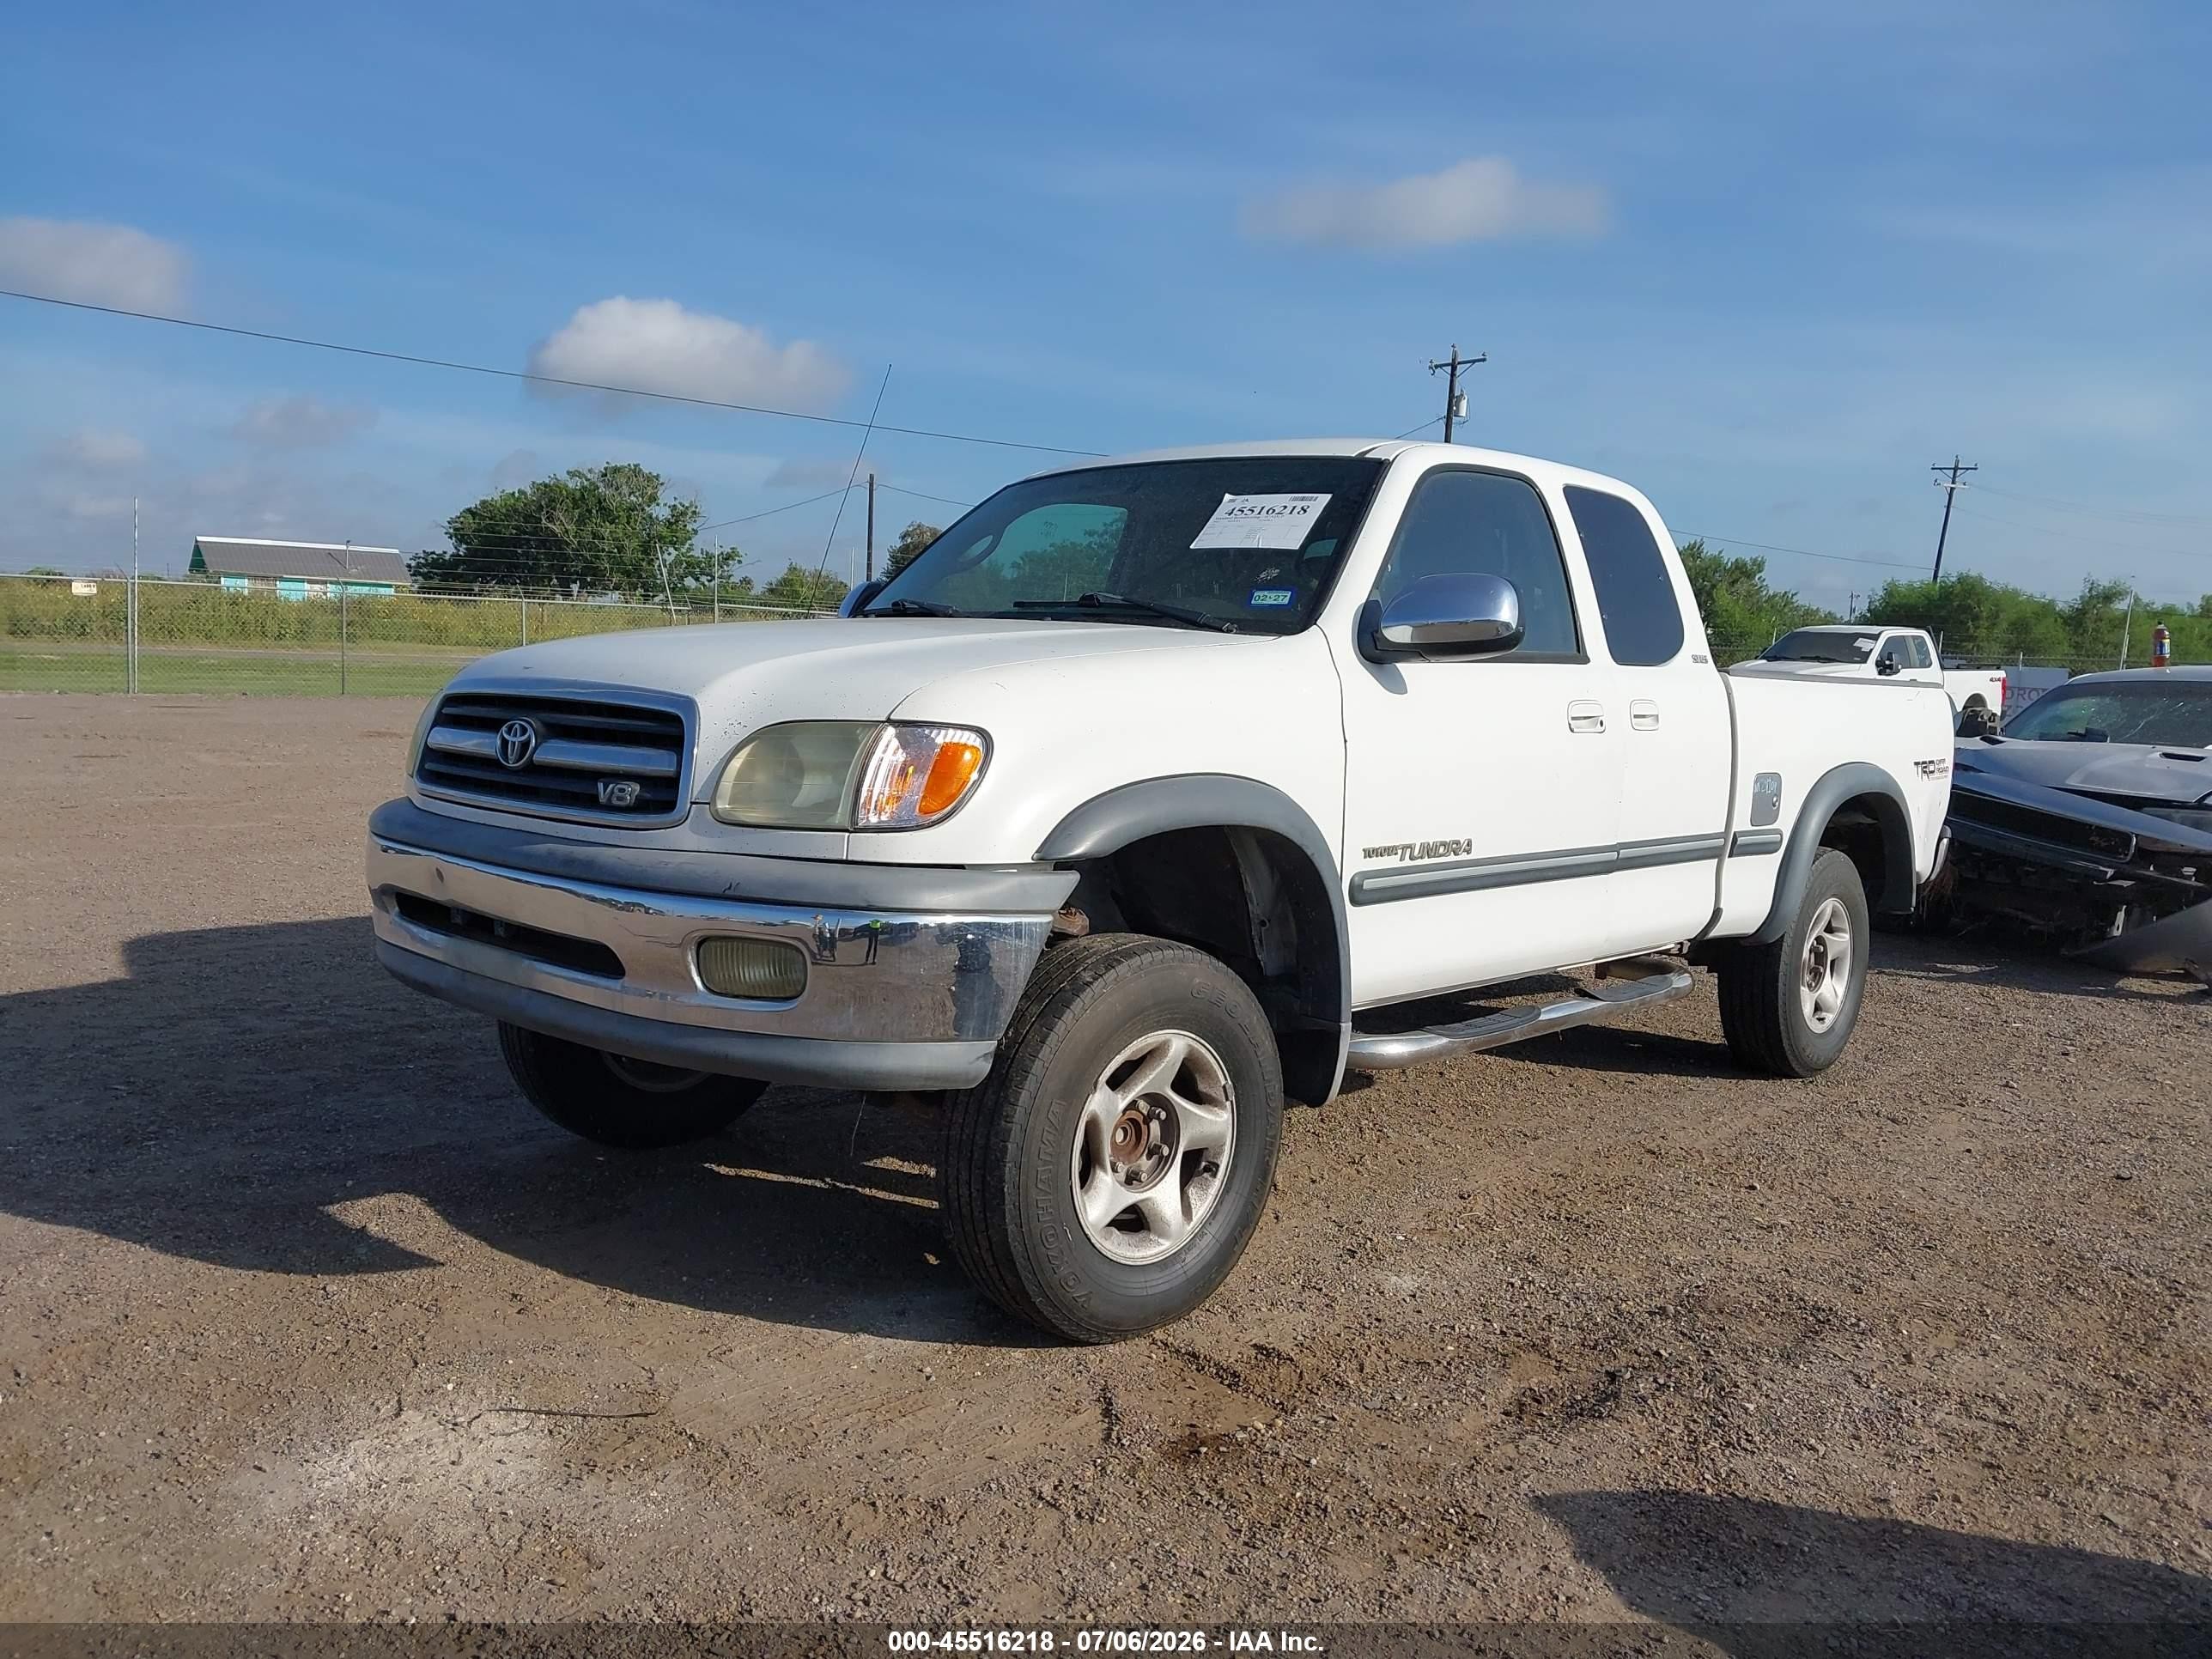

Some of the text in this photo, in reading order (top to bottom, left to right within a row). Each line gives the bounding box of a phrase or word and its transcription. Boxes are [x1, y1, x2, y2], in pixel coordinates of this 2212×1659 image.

[1224, 504, 1311, 517] 45516218
[1913, 760, 1936, 781] TRD
[597, 781, 640, 806] V8
[1399, 838, 1473, 862] TUNDRA
[1036, 1097, 1093, 1310] YOKOHAMA
